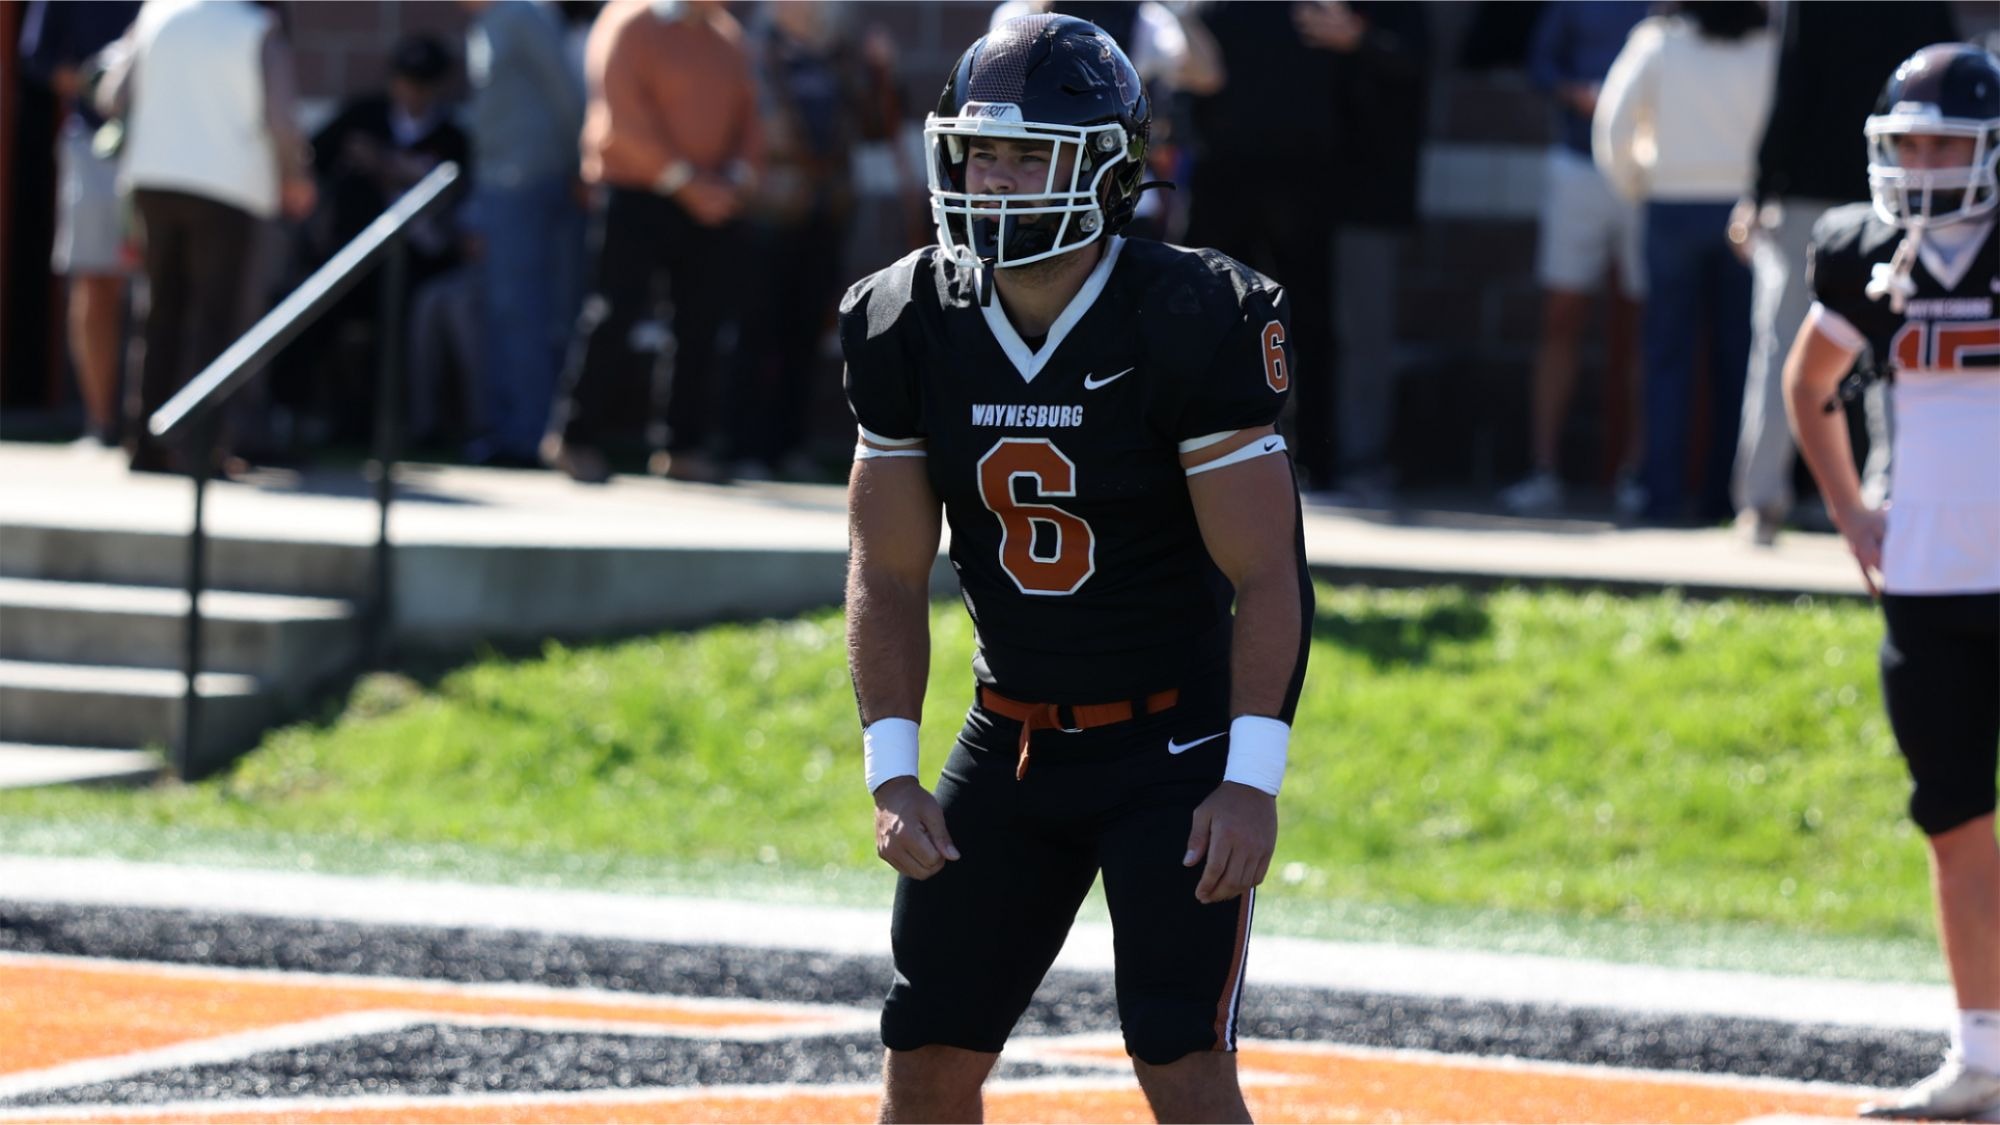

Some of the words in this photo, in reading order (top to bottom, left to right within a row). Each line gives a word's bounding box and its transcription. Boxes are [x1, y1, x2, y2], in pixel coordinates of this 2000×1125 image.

[1261, 320, 1289, 393] 6
[971, 404, 1084, 427] WAYNESBURG
[977, 437, 1095, 596] 6
